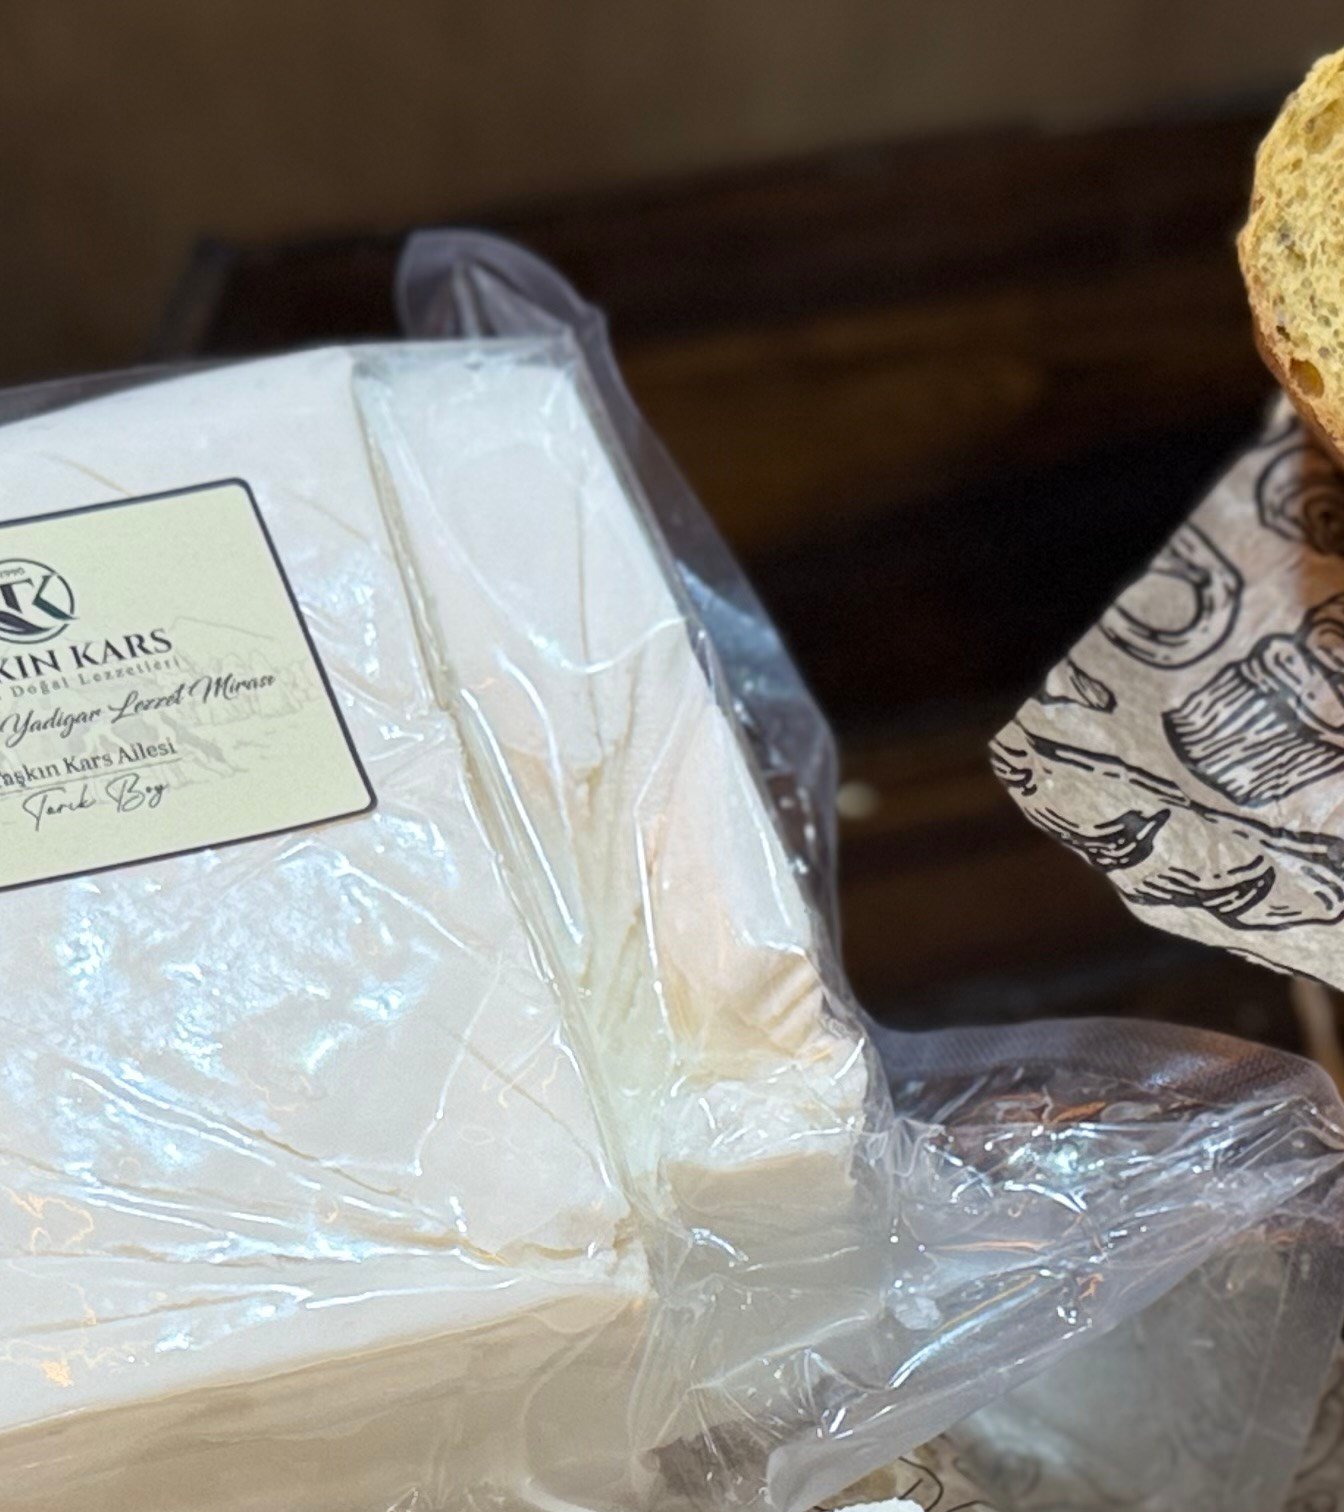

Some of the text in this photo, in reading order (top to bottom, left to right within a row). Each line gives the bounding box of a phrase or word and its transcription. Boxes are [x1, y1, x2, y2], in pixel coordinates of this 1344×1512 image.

[68, 627, 173, 669] KARS
[62, 754, 114, 775] Kars
[117, 736, 179, 765] Ailesi
